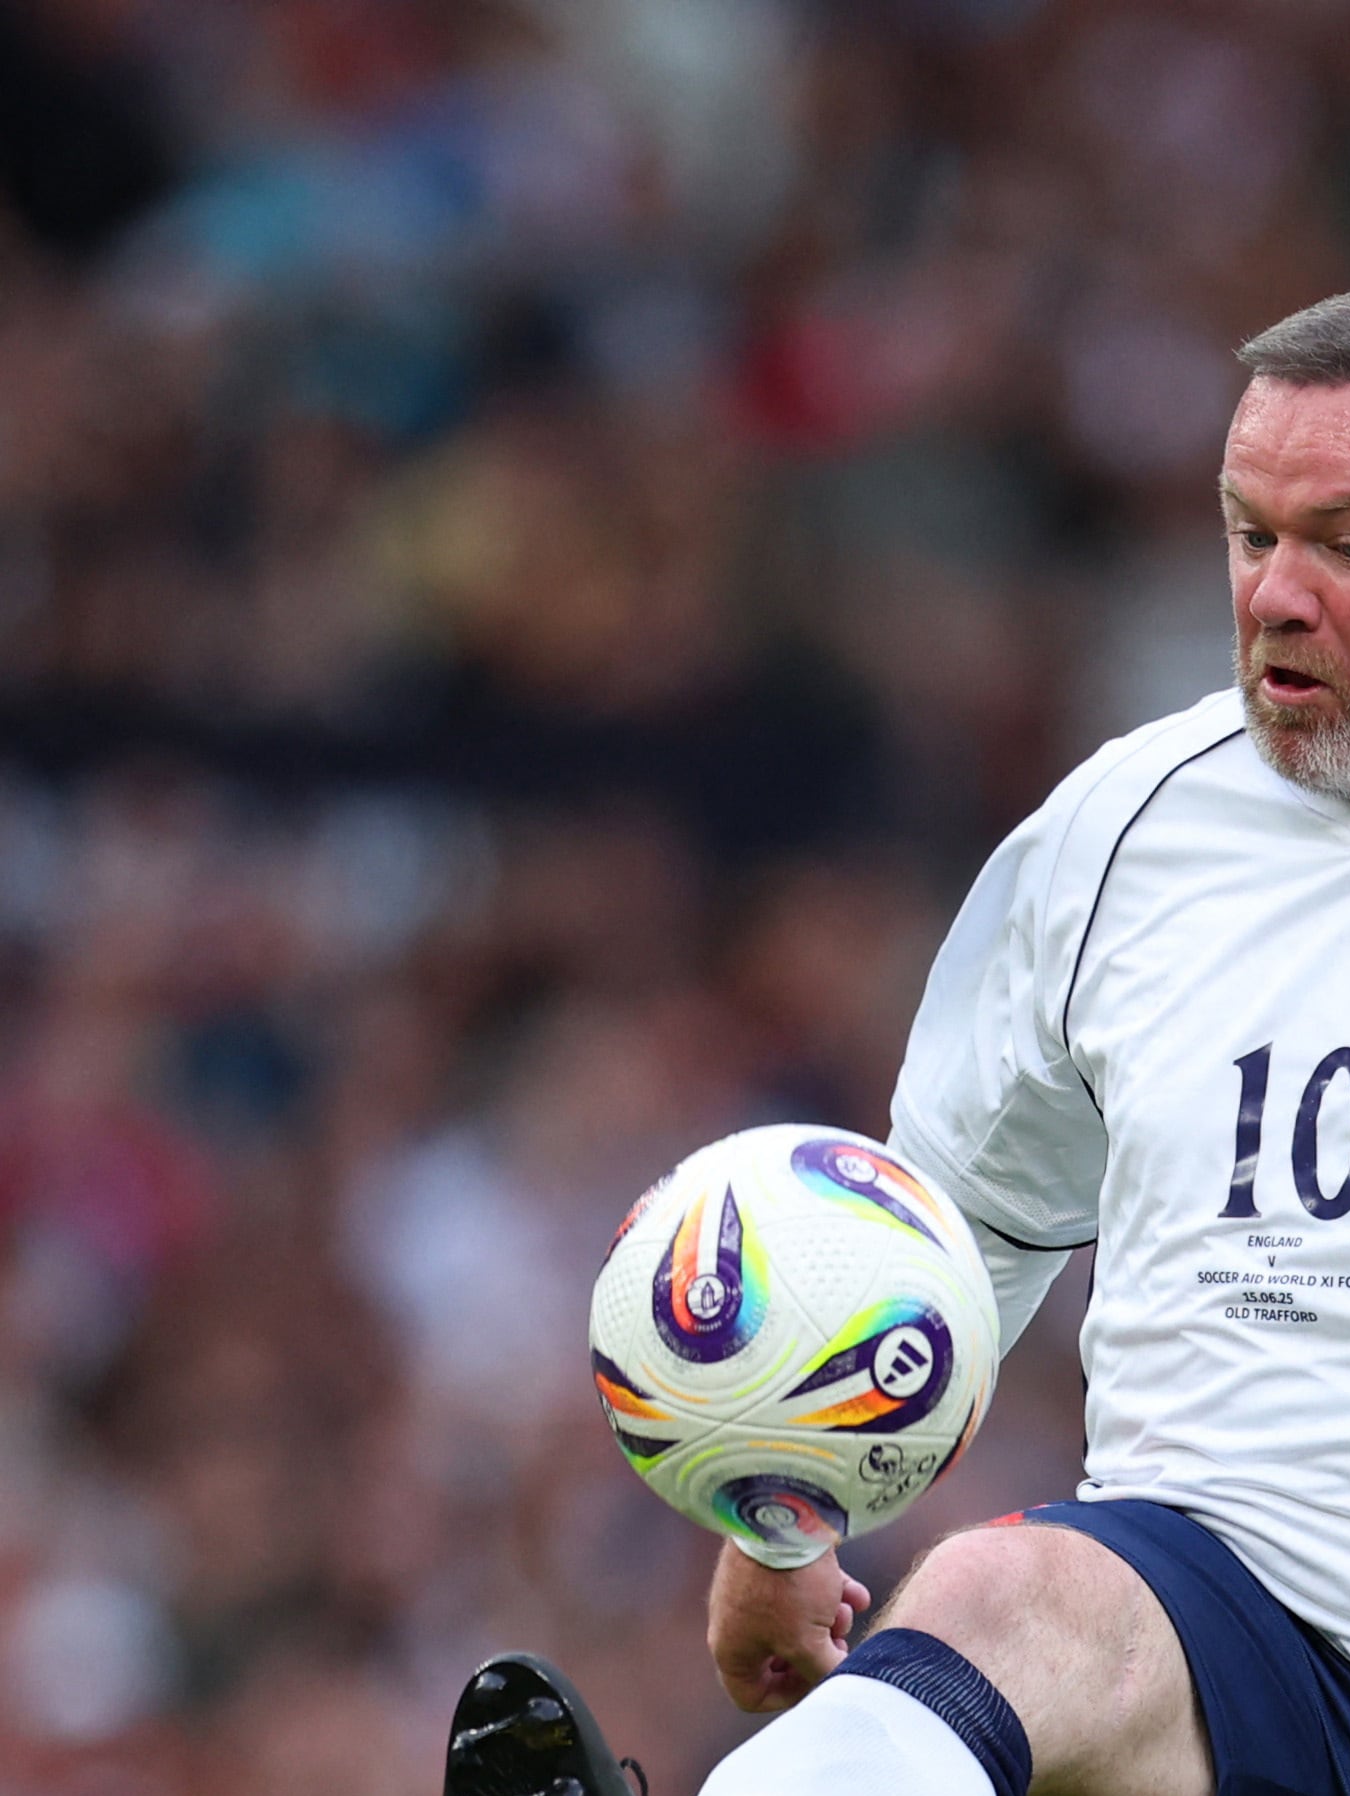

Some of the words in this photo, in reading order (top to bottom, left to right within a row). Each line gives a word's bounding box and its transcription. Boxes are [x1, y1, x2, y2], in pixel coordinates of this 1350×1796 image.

[1247, 1235, 1303, 1248] ENGLAND
[1267, 1255, 1276, 1268] V
[1197, 1271, 1240, 1284] SOCCER
[1241, 1273, 1264, 1285] AID
[1267, 1274, 1317, 1287] WORLD
[1320, 1275, 1334, 1288] XI
[1242, 1291, 1294, 1305] 15.06.25
[1225, 1307, 1250, 1320] OLD
[1254, 1308, 1318, 1322] TRAFFORD
